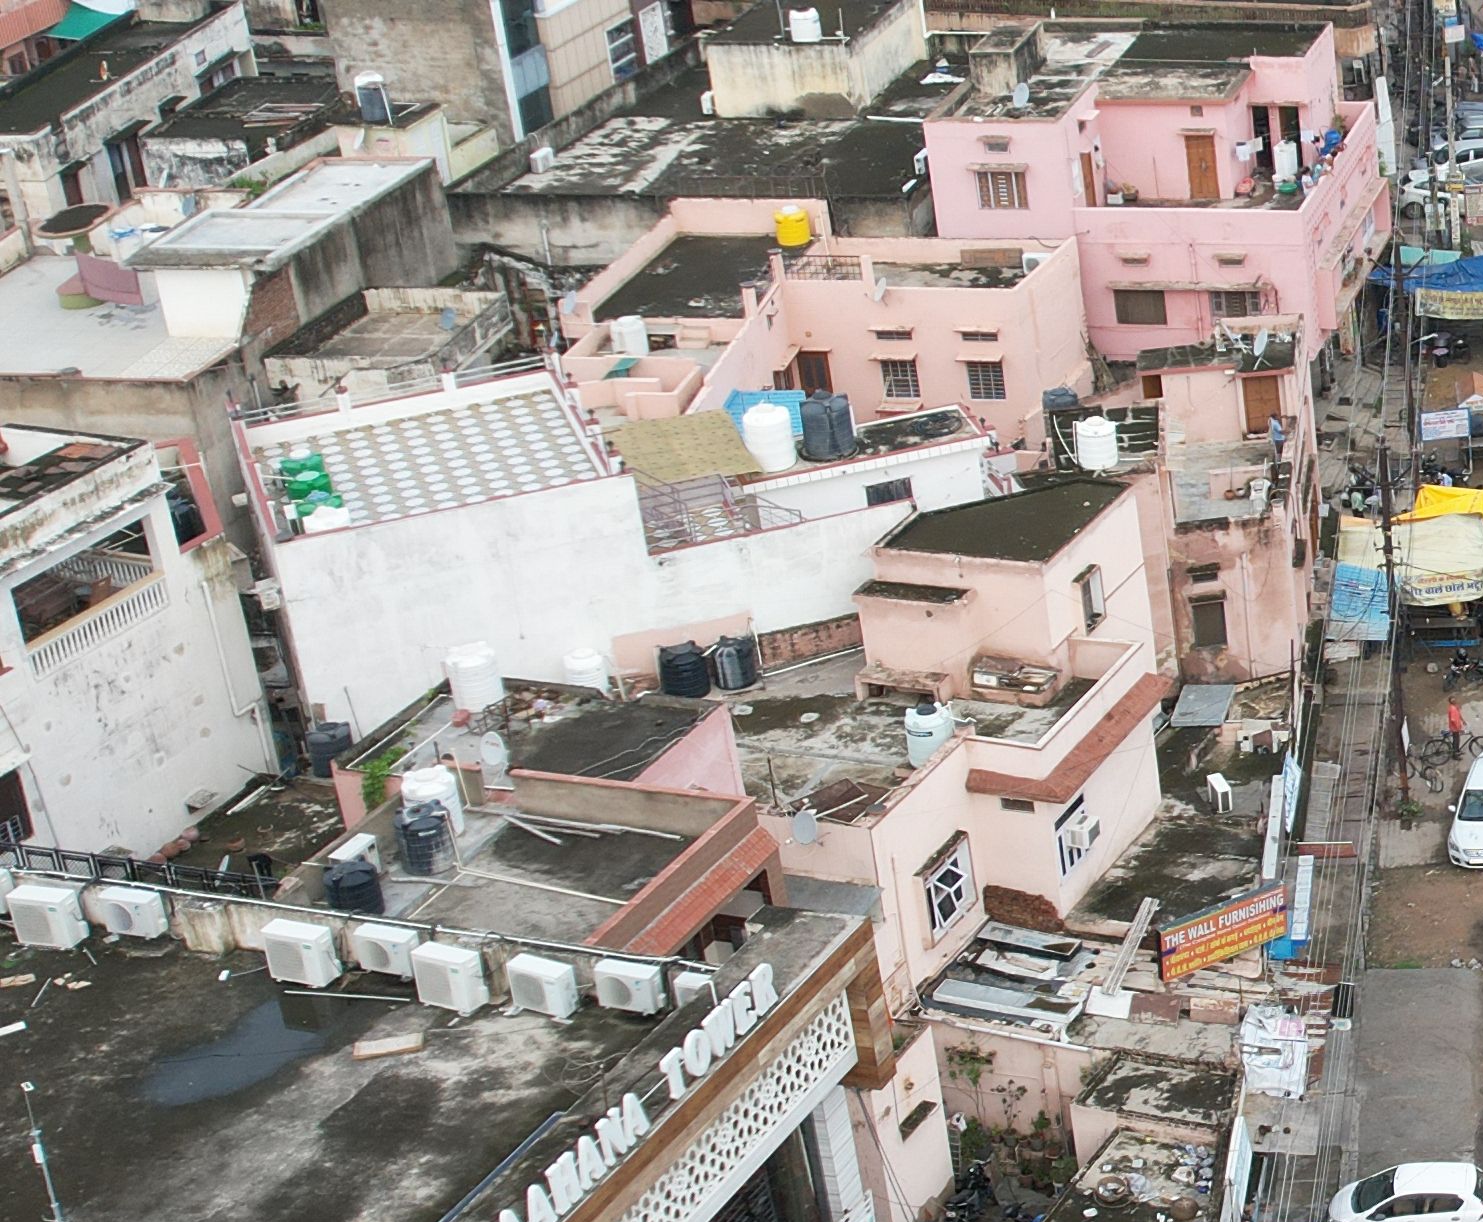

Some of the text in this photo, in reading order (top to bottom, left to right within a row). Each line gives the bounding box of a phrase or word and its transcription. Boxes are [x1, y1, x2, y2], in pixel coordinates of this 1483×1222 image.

[1164, 931, 1186, 949] THE
[1187, 920, 1216, 940] WALL
[659, 962, 779, 1100] TOWER
